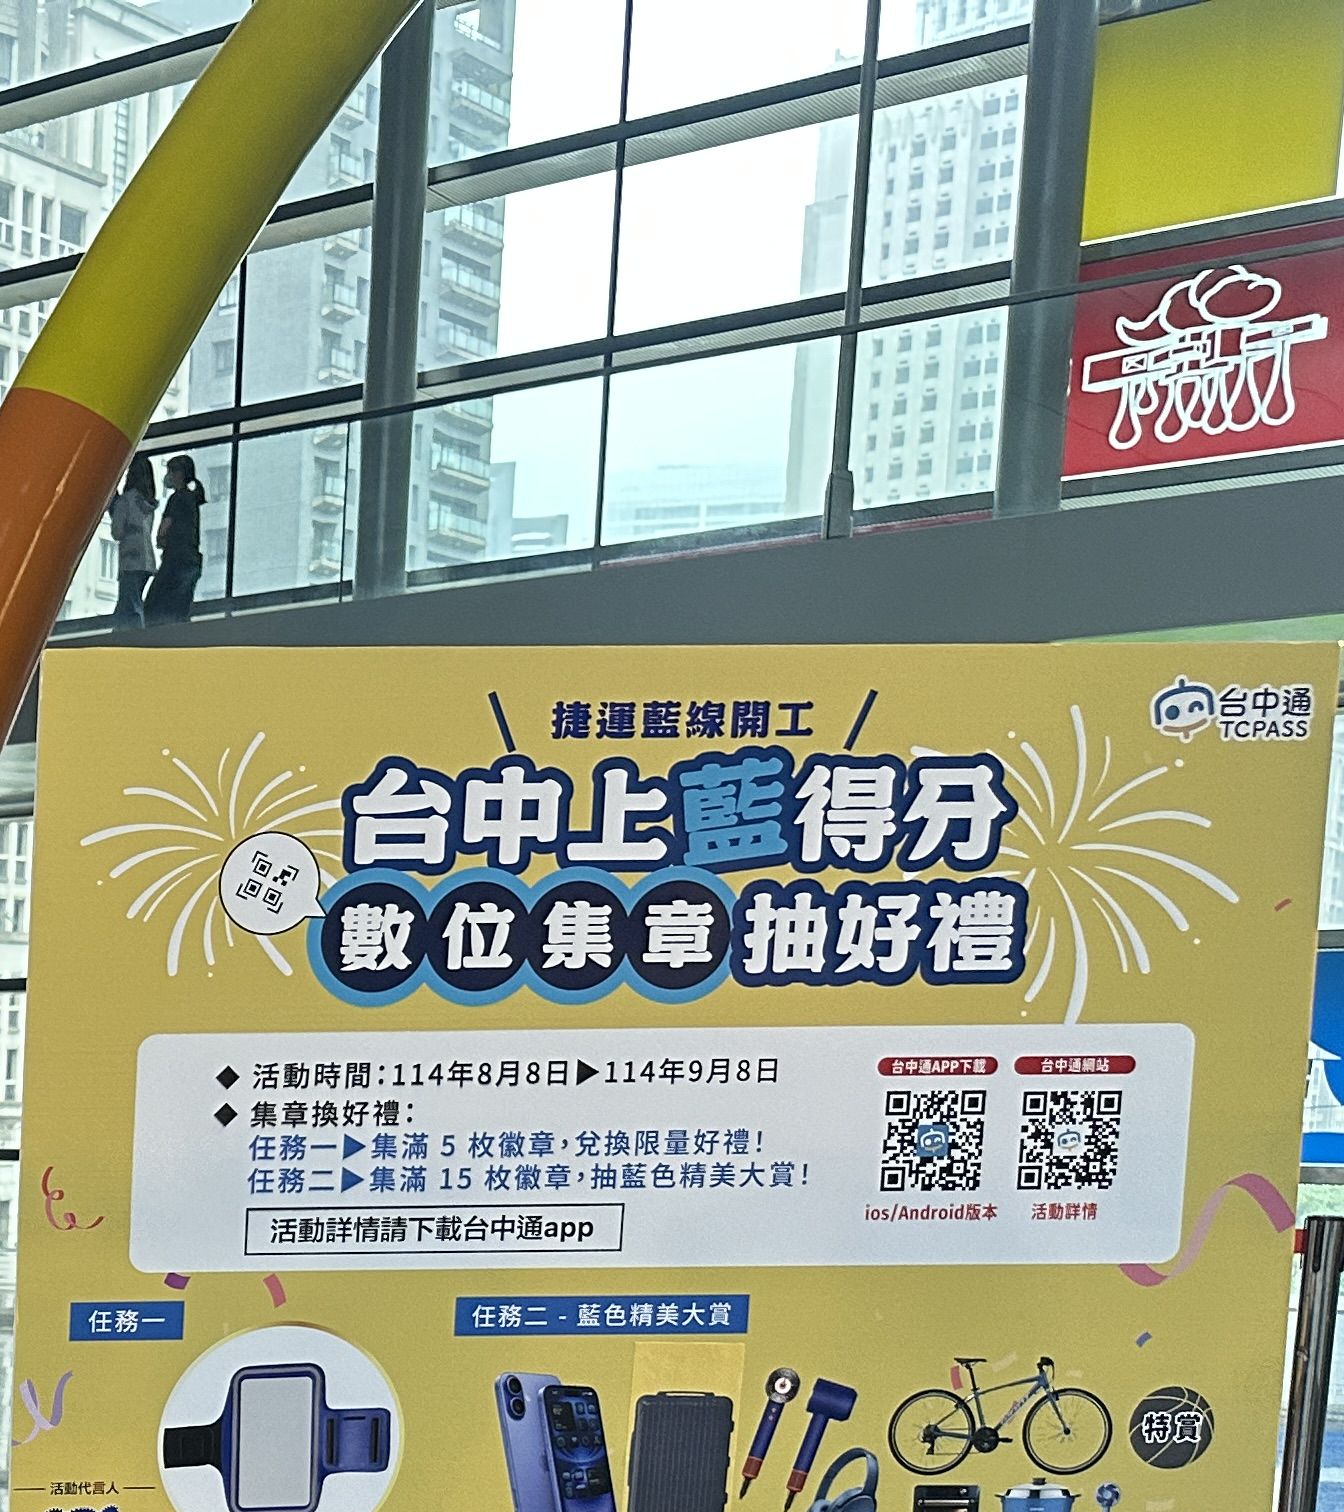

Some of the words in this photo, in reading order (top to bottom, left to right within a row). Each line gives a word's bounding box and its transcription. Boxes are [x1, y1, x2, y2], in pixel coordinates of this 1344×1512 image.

[1219, 687, 1311, 717] 台中通
[551, 699, 815, 741] 捷運藍線開工
[1219, 720, 1308, 738] TCPASS
[348, 748, 1012, 870] 台中上藍得分
[439, 1166, 473, 1190] 15
[1031, 1203, 1098, 1222] 活動詳情
[88, 1310, 166, 1334] 任務一
[1142, 1412, 1203, 1443] 特賞
[50, 1481, 119, 1496] 活動代言人
